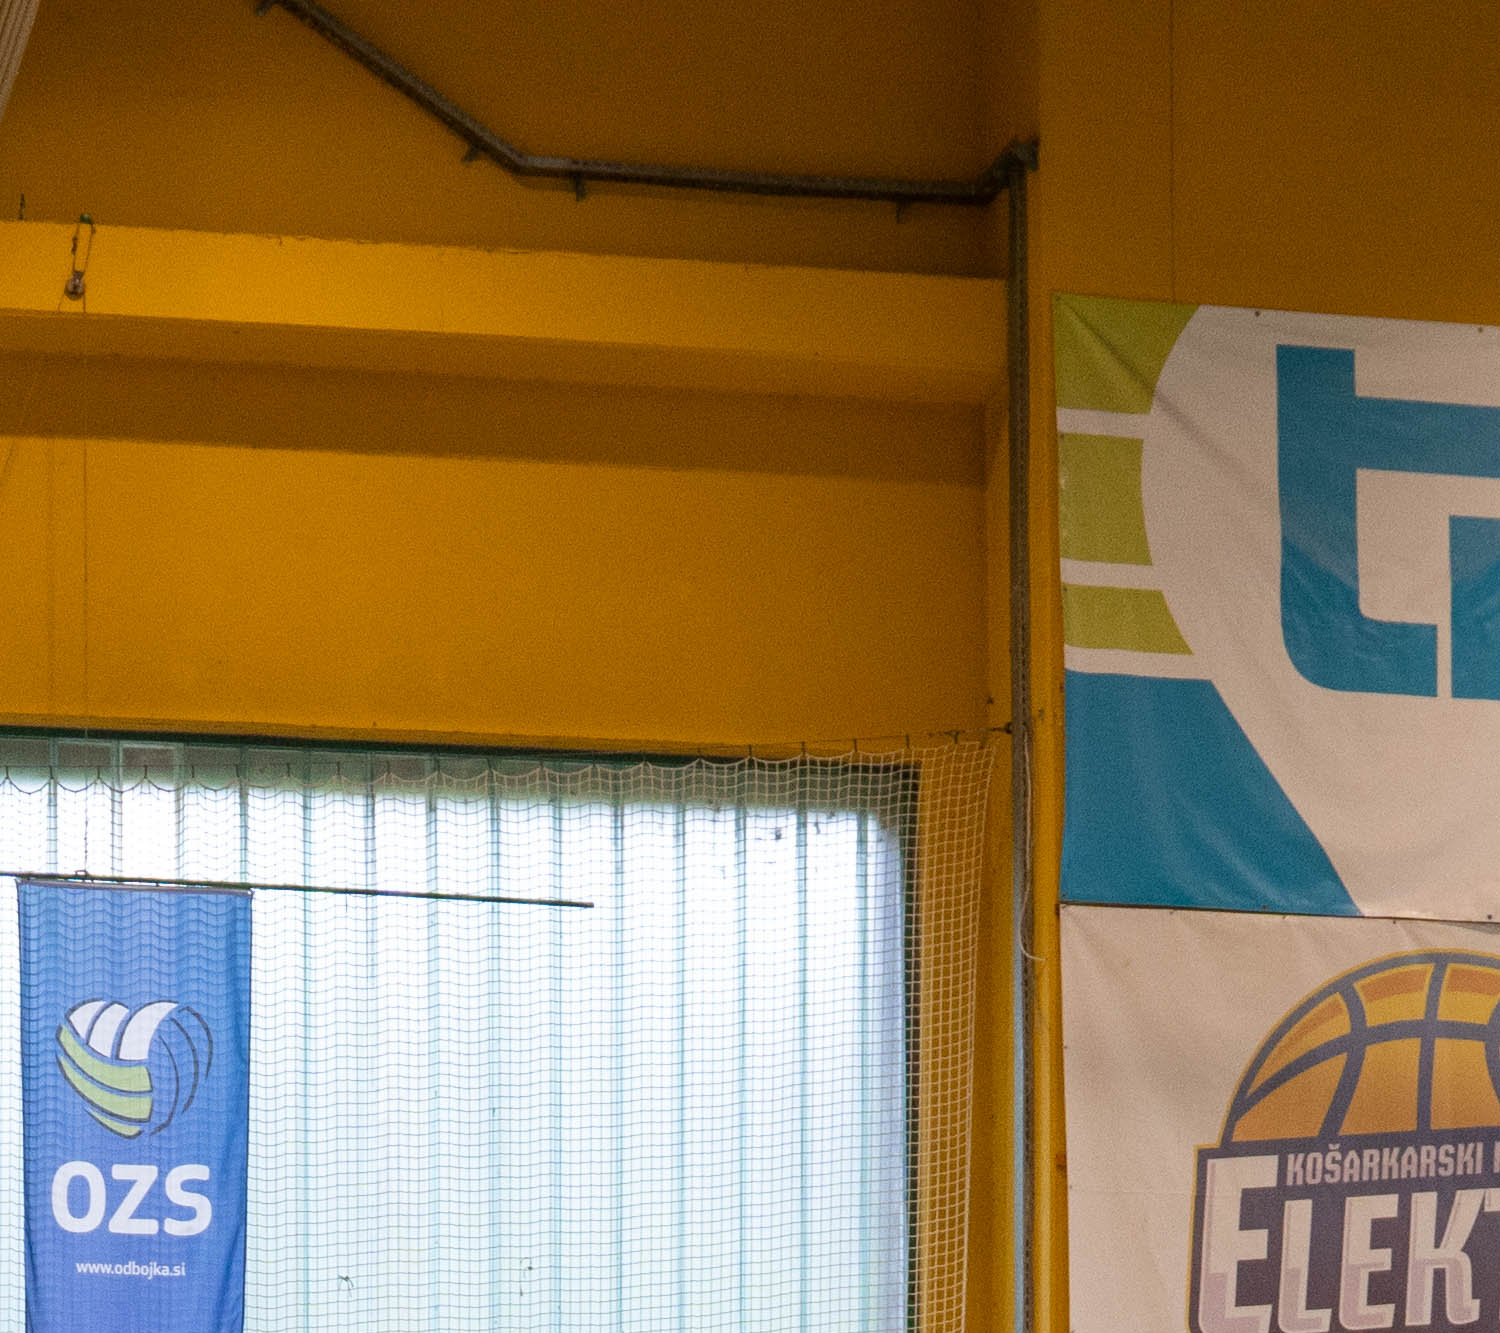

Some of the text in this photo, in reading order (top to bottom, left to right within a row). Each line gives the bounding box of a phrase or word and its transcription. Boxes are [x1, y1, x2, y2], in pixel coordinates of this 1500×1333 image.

[1285, 1140, 1484, 1187] KOŠARKARSKI
[50, 1160, 214, 1236] OZS
[75, 1260, 188, 1281] www.odbojka.si
